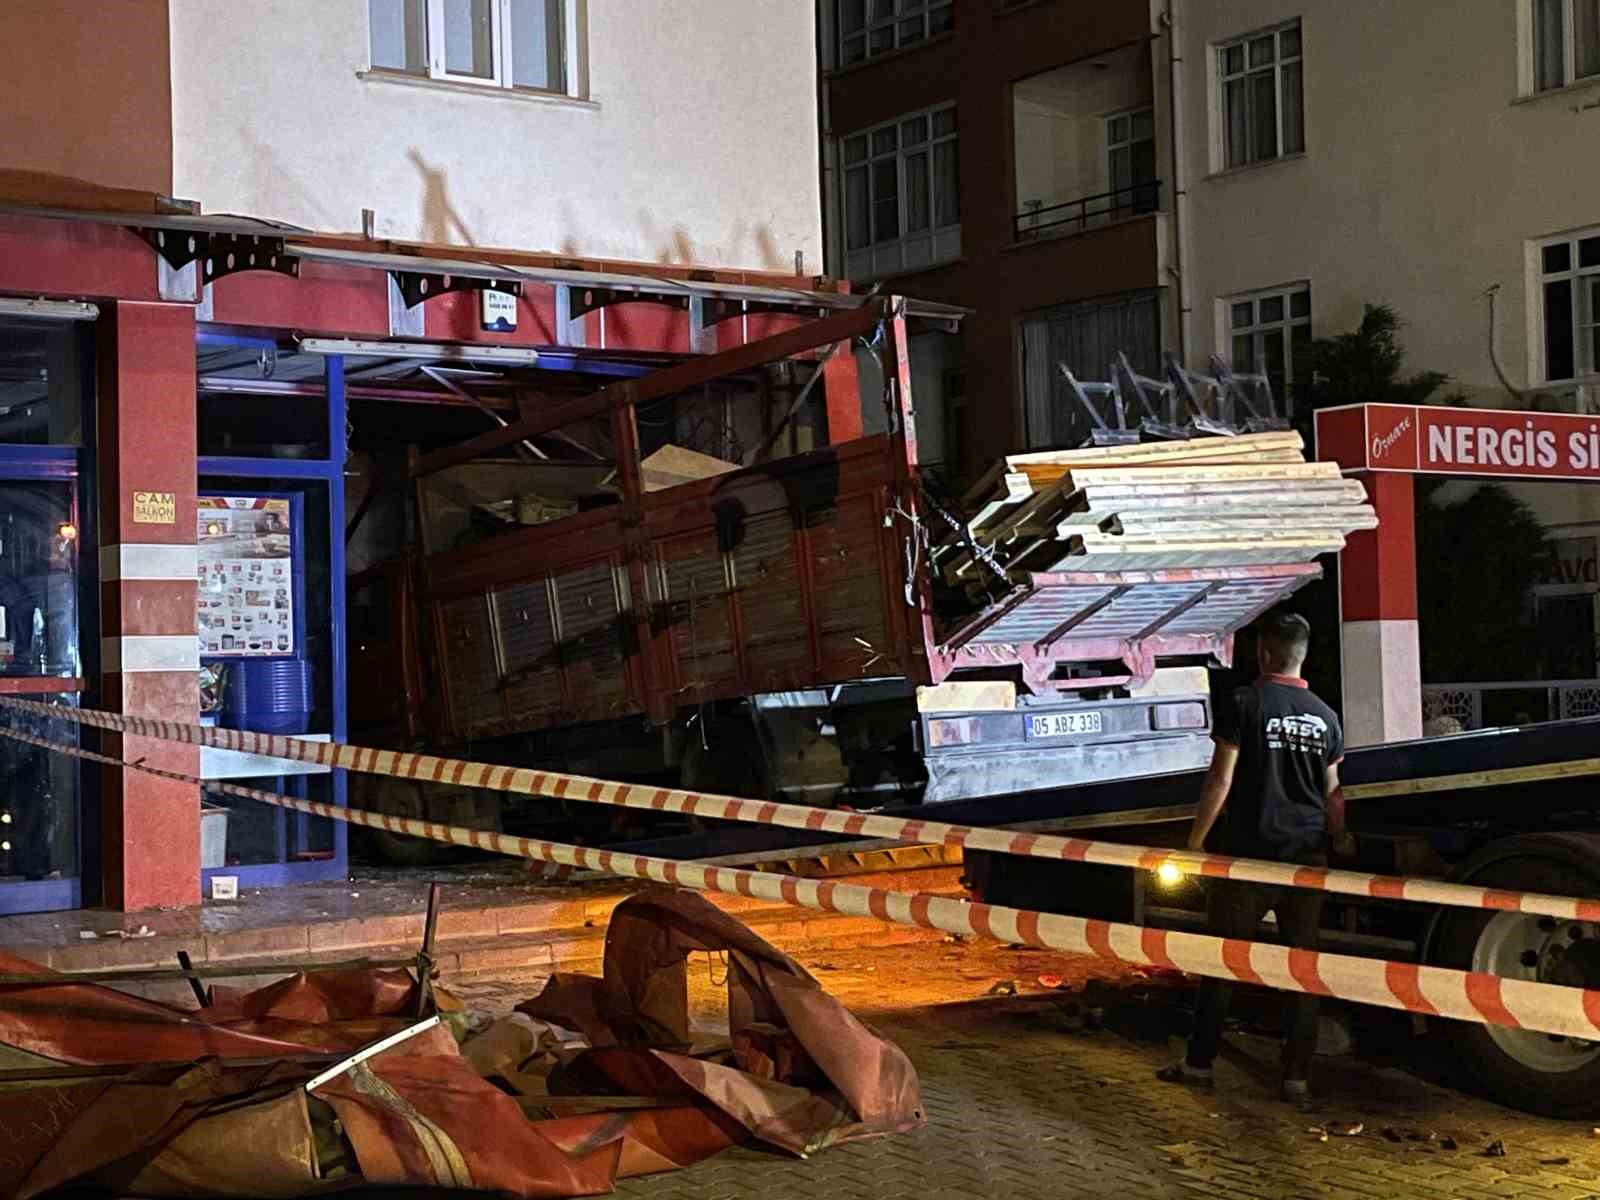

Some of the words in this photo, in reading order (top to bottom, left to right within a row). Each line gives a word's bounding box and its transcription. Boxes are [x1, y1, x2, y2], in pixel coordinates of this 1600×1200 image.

[1428, 420, 1557, 468] NERGİS
[1568, 424, 1600, 470] Sİ
[135, 492, 174, 504] CAM
[1034, 717, 1049, 735] 05
[1055, 715, 1076, 733] ABZ
[1079, 713, 1100, 731] 338
